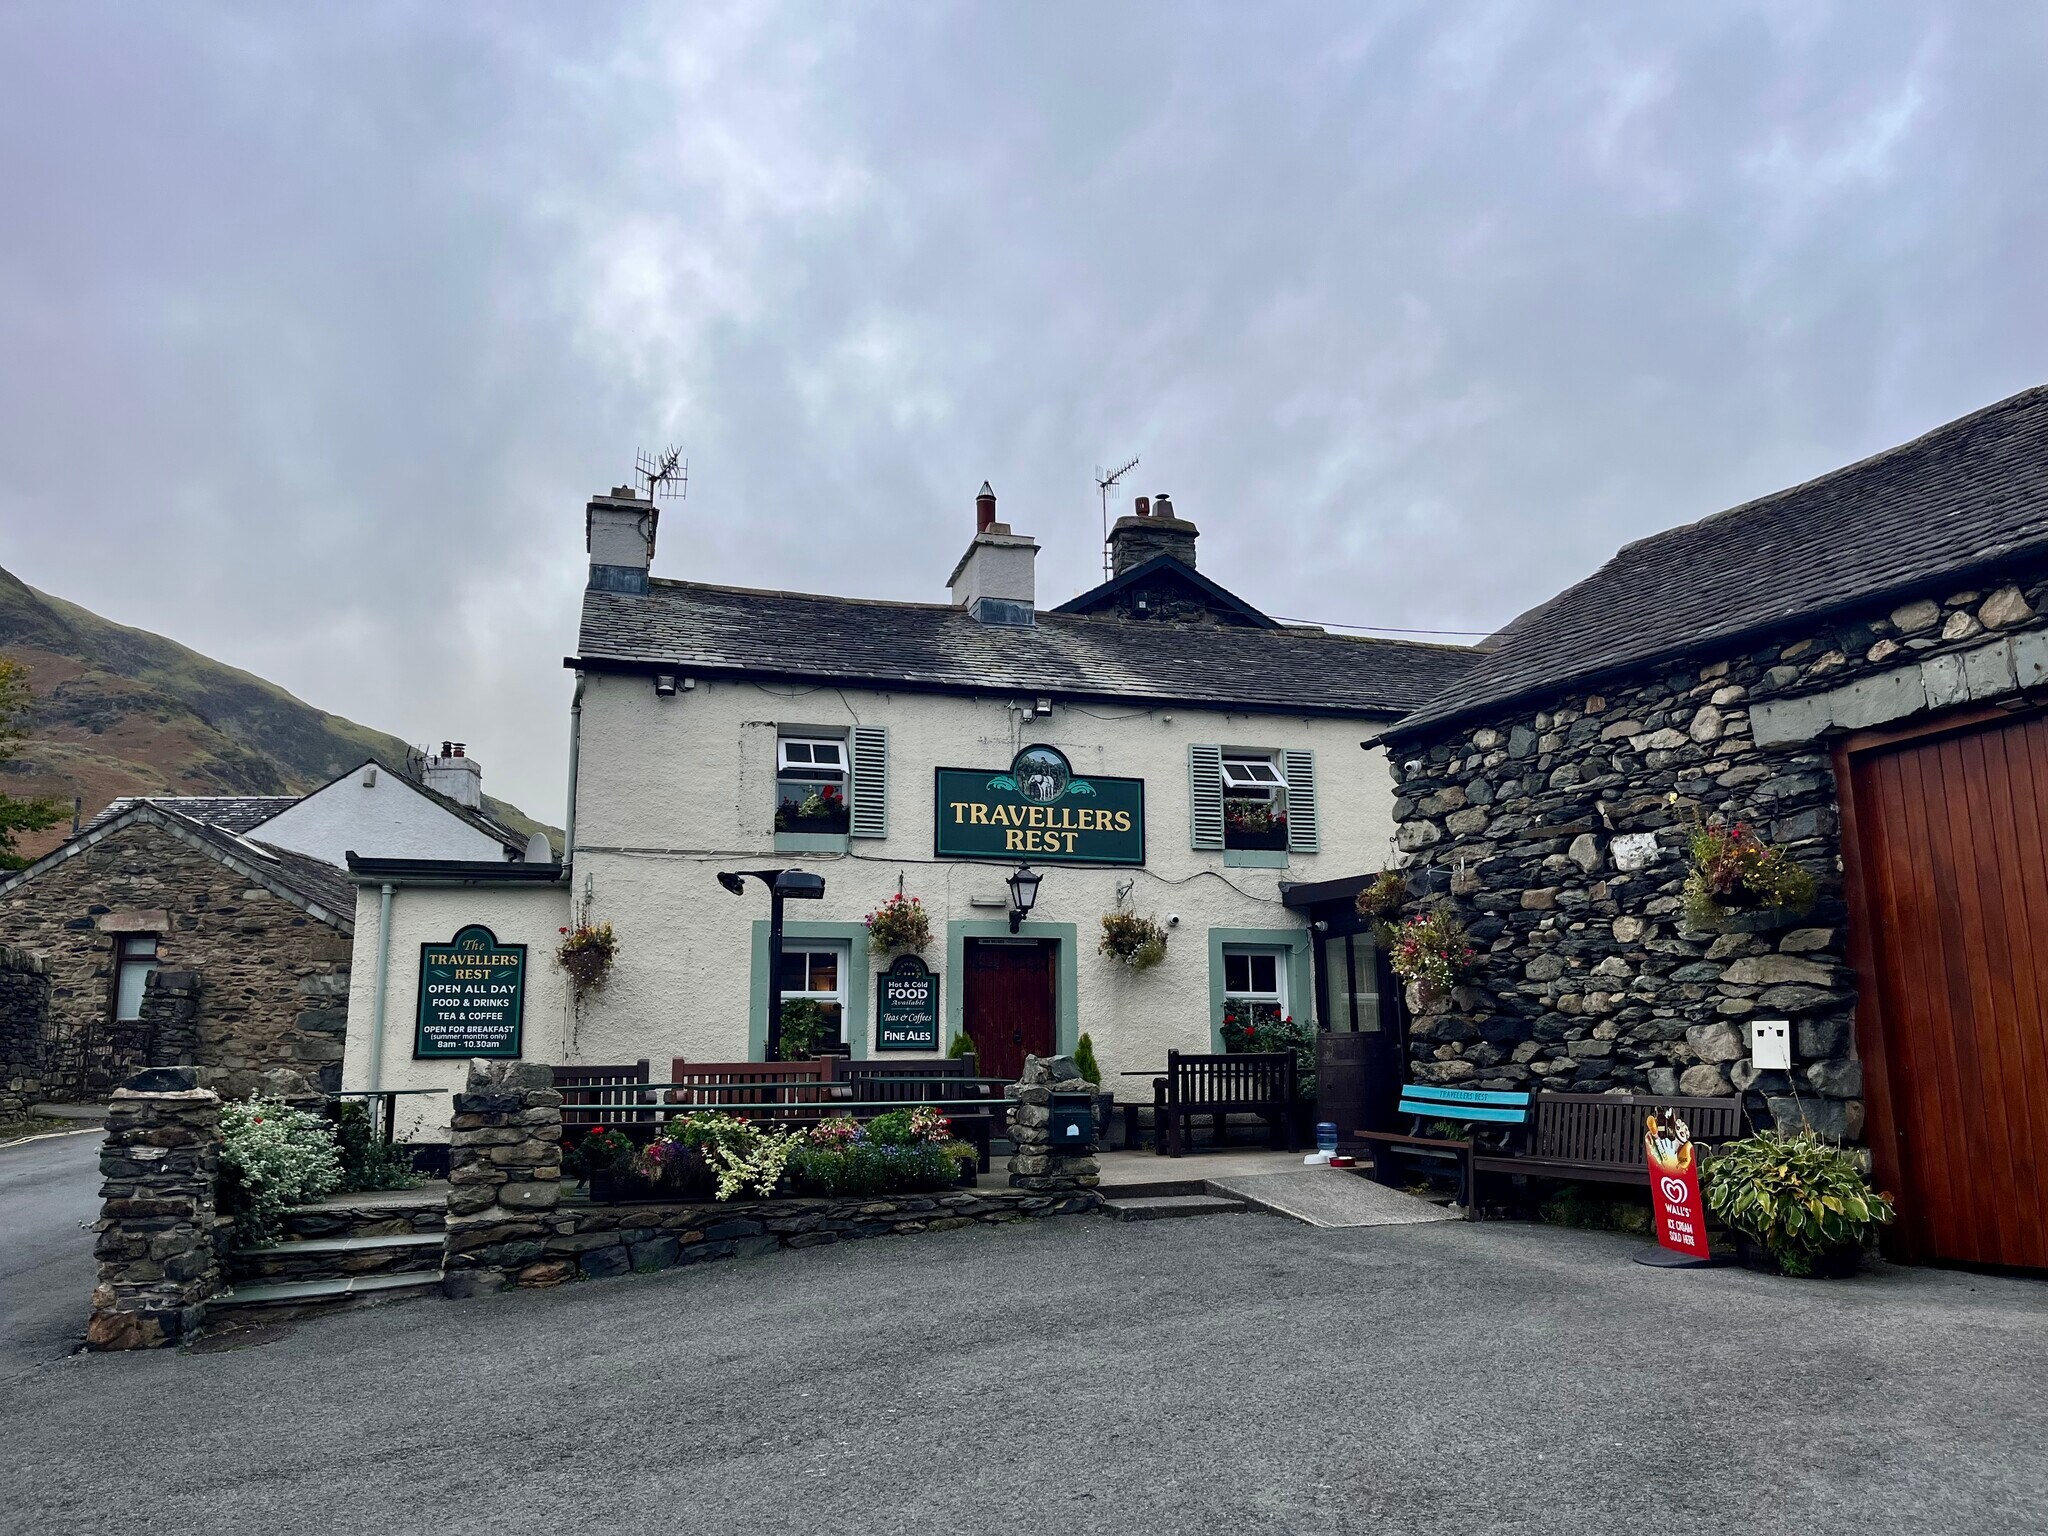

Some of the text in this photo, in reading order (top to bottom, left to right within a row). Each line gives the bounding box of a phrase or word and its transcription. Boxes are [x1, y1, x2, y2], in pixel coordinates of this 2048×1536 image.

[950, 802, 1131, 832] TRAVELLERS
[1005, 829, 1078, 853] REST
[462, 939, 485, 951] The
[429, 954, 518, 966] TRAVELLERS
[455, 969, 491, 980] REST
[428, 984, 516, 994] OPEN ALL DAY
[888, 988, 928, 999] FOOD
[432, 998, 510, 1007] FOOD & DRINKS
[438, 1012, 503, 1020] TEA & COFFEE
[883, 1012, 932, 1024] Teas & Coffees
[884, 1030, 931, 1041] FINE ALES
[1440, 1090, 1488, 1101] TRAVELLERS REST
[1664, 1203, 1690, 1218] WALL'S
[1667, 1218, 1693, 1234] ICE CREAM
[1669, 1230, 1696, 1247] SOLD HERE
